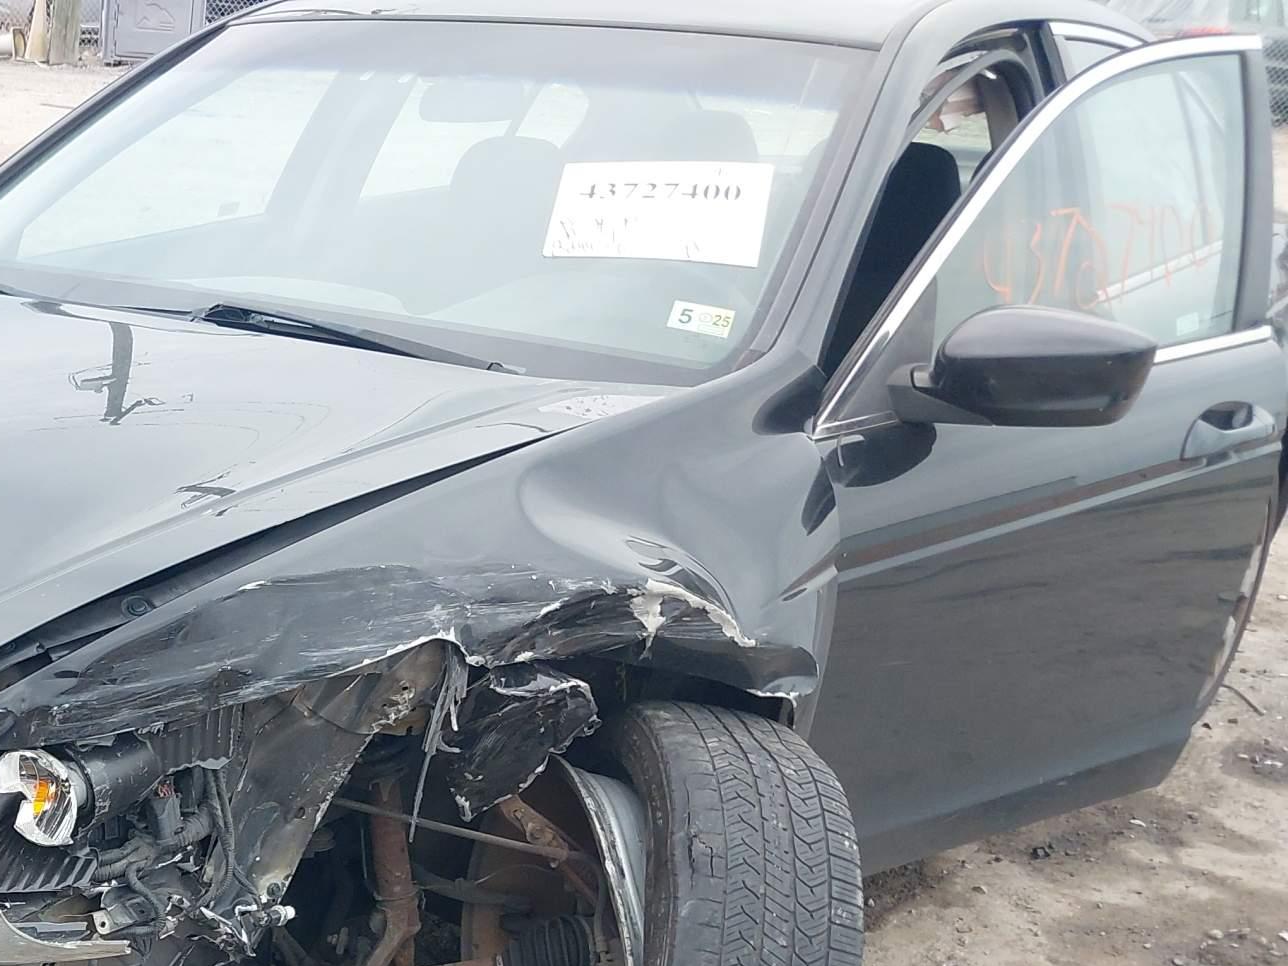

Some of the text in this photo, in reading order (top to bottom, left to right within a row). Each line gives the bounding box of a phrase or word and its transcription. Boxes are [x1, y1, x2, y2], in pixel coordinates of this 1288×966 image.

[579, 182, 743, 201] 43727400
[677, 308, 732, 328] 5 25
